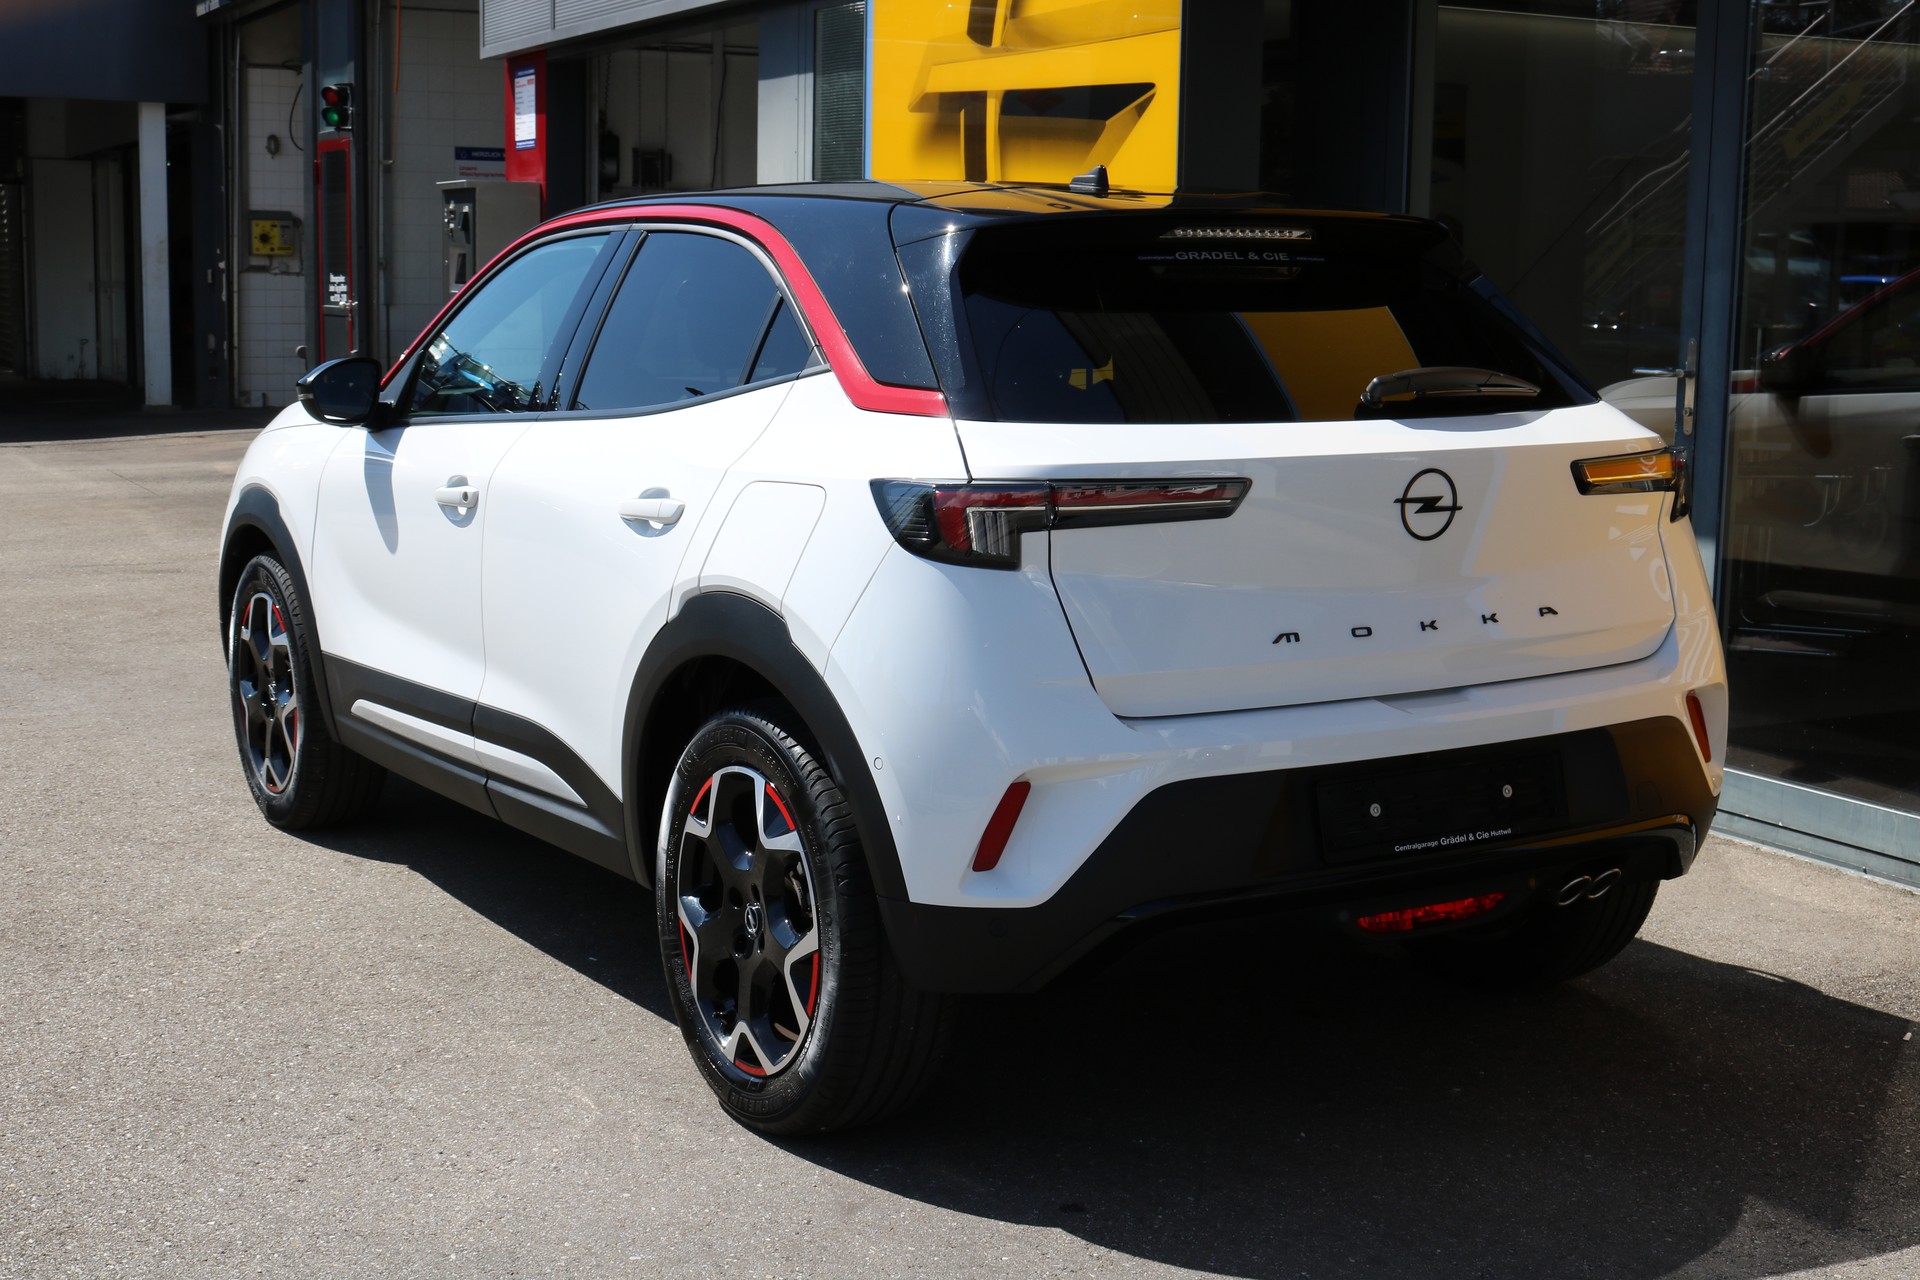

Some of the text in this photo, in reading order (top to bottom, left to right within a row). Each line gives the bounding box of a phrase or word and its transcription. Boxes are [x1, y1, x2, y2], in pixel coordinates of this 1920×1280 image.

[1175, 249, 1244, 261] GRÄDEL
[1248, 252, 1260, 261] &
[1263, 252, 1290, 262] CIE
[1272, 606, 1559, 644] MOKKA
[1394, 828, 1512, 852] Centralgarage Grädel & Cie Huttwil
